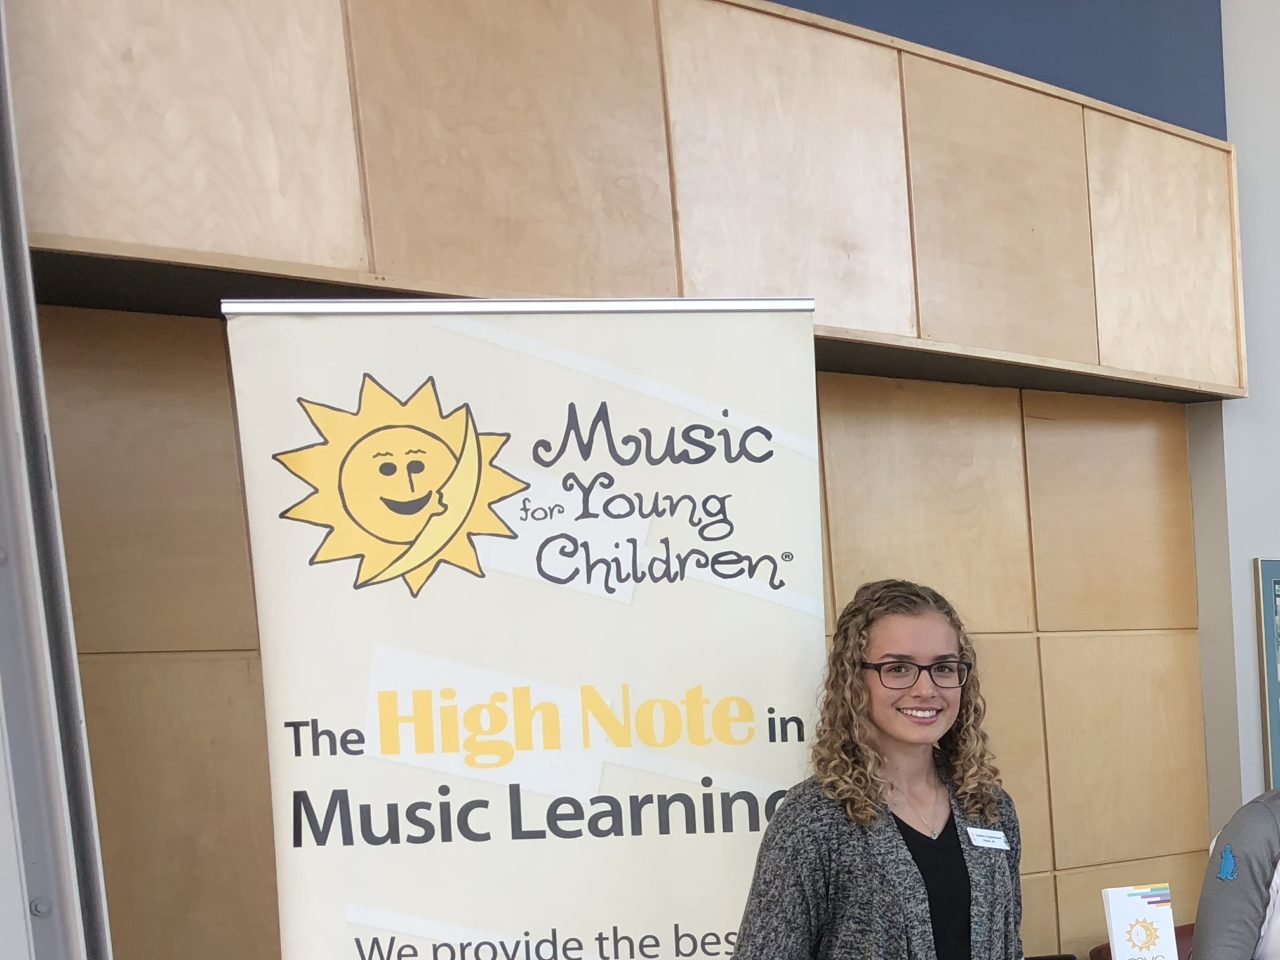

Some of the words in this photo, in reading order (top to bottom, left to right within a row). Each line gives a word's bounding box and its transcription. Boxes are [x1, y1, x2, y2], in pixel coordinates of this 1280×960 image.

[533, 402, 774, 466] Music
[519, 497, 565, 522] for
[562, 472, 734, 542] Young
[284, 719, 365, 756] The
[377, 686, 561, 769] High
[580, 683, 755, 750] Note
[768, 707, 805, 743] in
[293, 785, 491, 848] Music
[595, 926, 661, 960] the
[673, 923, 738, 958] bes
